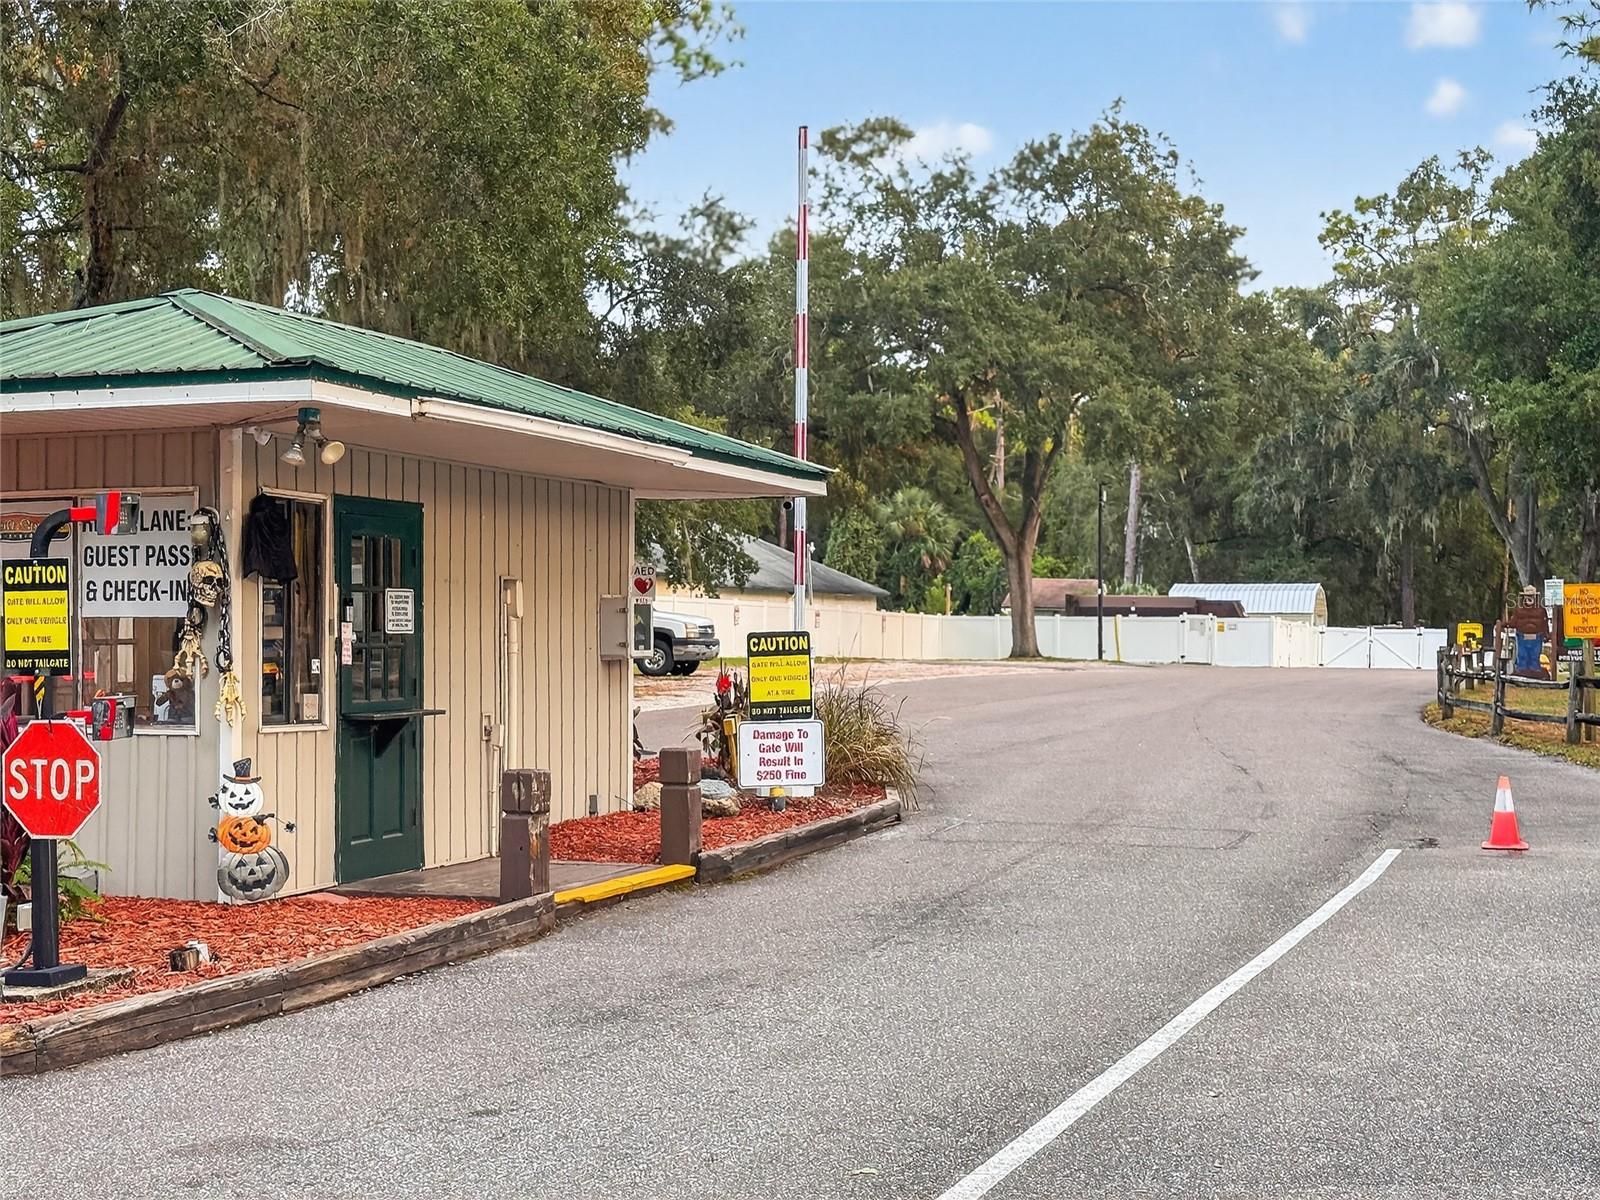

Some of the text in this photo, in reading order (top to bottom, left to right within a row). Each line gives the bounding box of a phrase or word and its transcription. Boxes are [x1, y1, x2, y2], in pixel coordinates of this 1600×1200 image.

[83, 544, 190, 567] GUEST PASS
[5, 565, 67, 585] CAUTION
[634, 566, 655, 576] AED
[86, 579, 187, 602] & CHECK-IN
[7, 598, 23, 606] GATE
[42, 597, 66, 605] ALLOW
[749, 635, 808, 652] CAUTION
[6, 658, 69, 668] DO NOT TAILGATE
[751, 661, 768, 669] GATE
[751, 705, 811, 716] DO NOT TAILGATE
[752, 728, 809, 742] Damage To
[758, 742, 804, 753] Gate Will
[759, 755, 804, 767] Result In
[9, 758, 95, 801] STOP
[756, 769, 807, 781] $250 Fine
